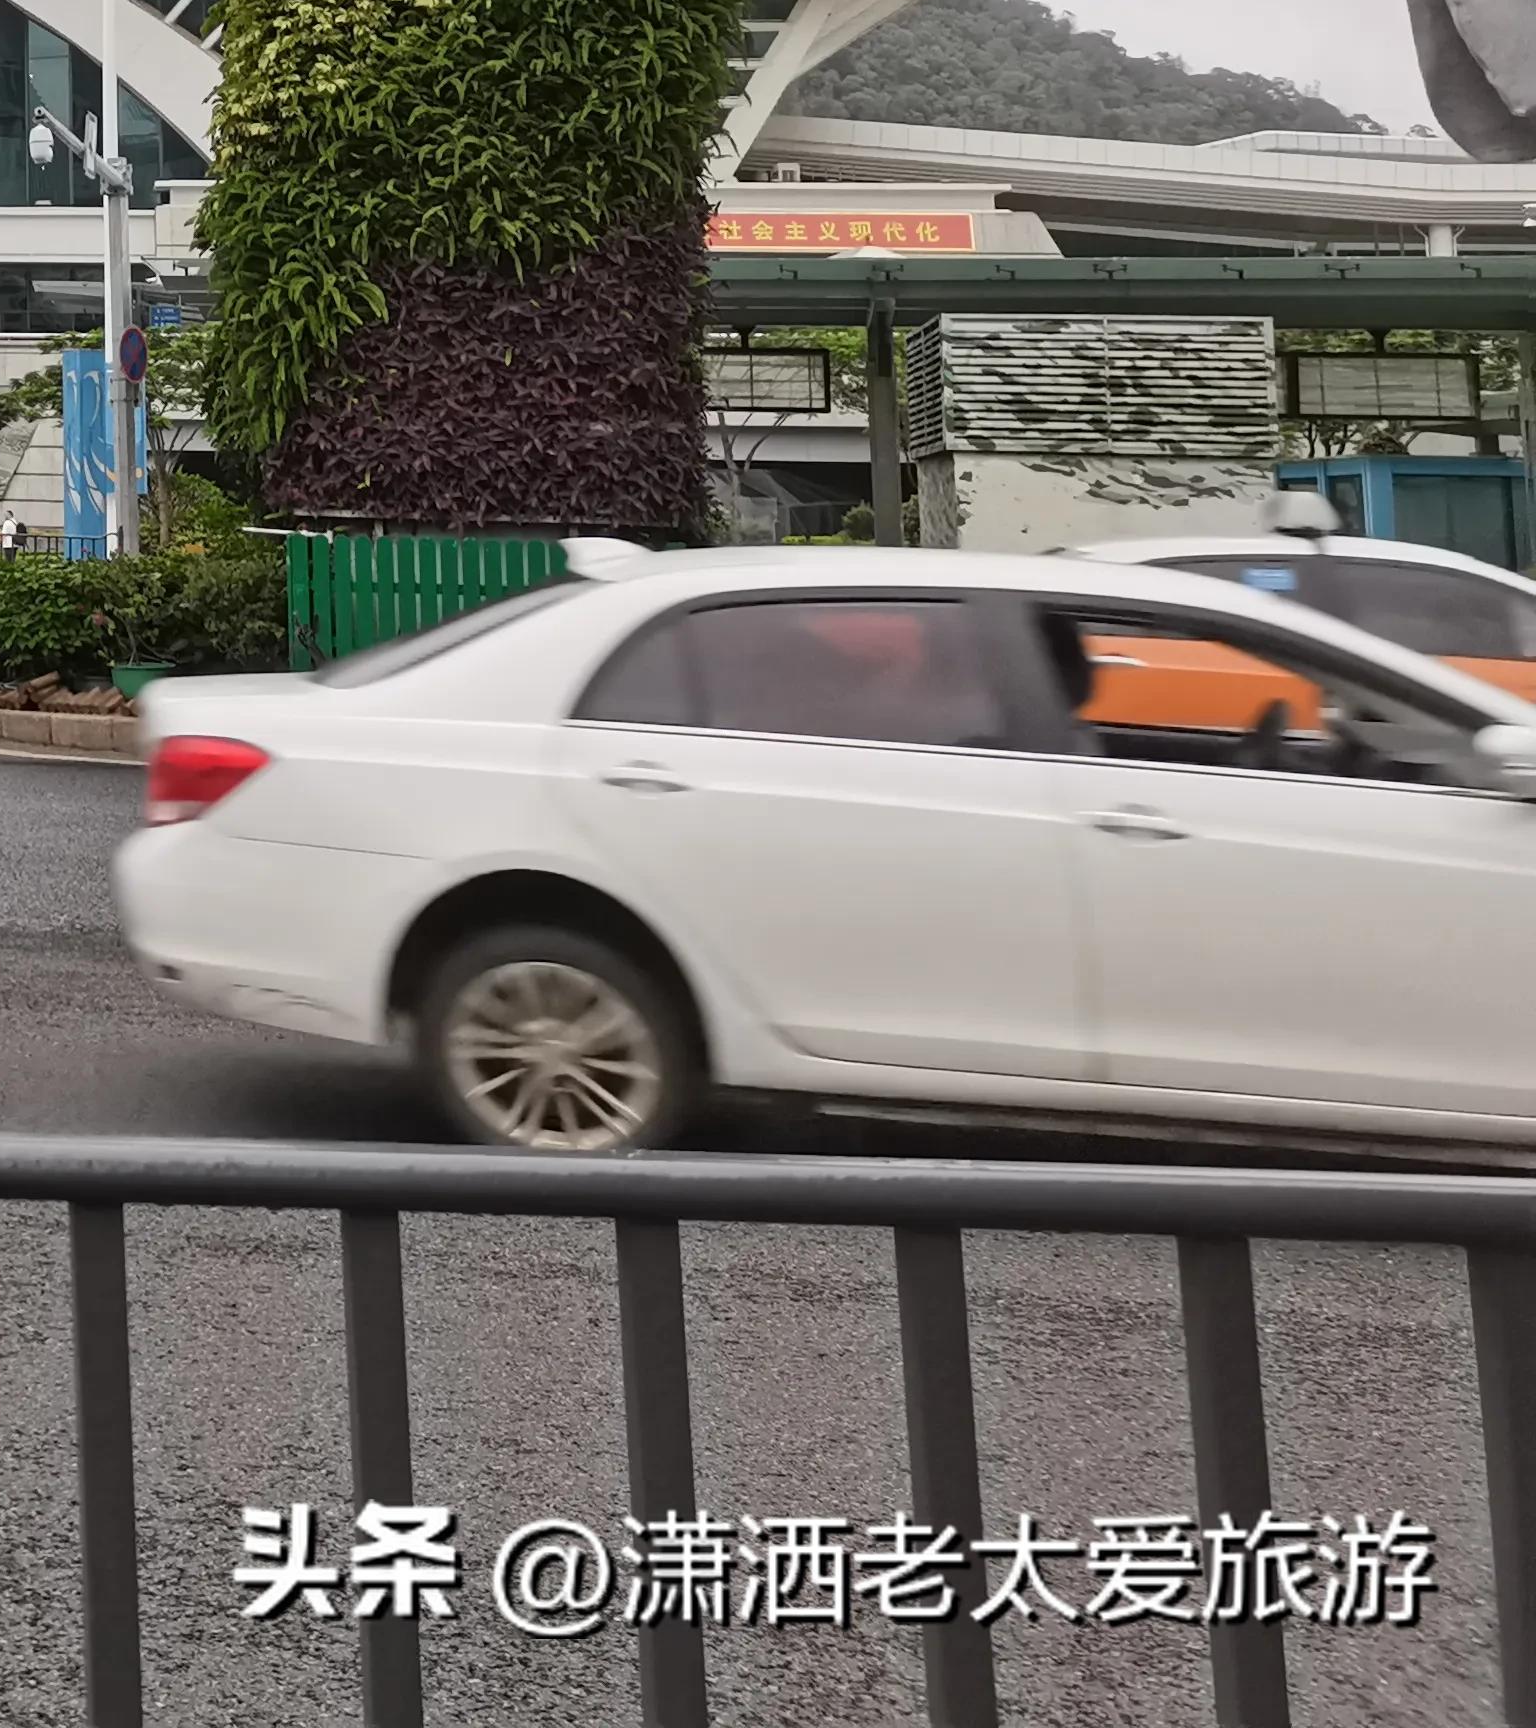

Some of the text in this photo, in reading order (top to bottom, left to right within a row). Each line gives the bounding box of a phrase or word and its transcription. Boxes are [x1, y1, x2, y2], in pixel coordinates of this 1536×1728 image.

[704, 219, 940, 243] 社会主义现代化
